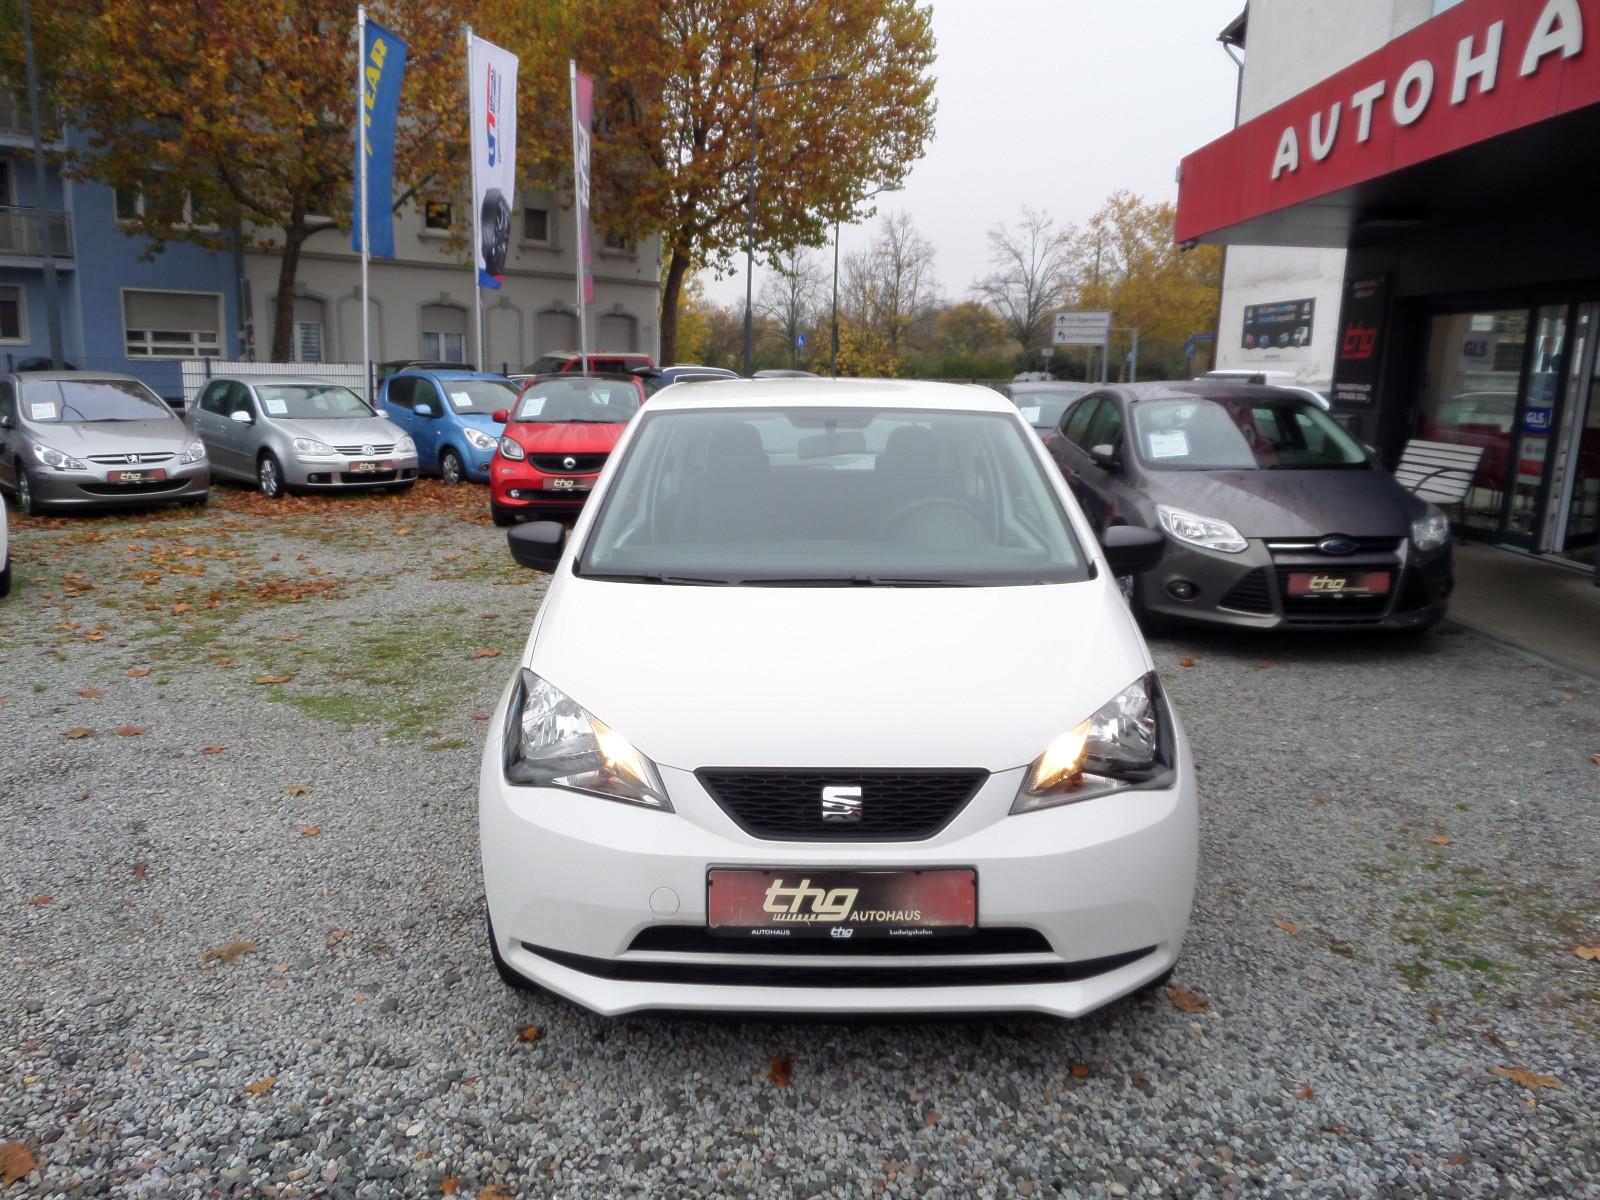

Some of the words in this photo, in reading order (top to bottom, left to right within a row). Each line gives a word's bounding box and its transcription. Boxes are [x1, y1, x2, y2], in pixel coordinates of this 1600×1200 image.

[1270, 0, 1584, 180] AUTOHA
[1526, 412, 1545, 424] GLS
[1309, 575, 1347, 592] thg
[763, 879, 859, 922] thg
[849, 910, 922, 922] AUTOHAUS
[830, 926, 854, 938] thg
[889, 928, 933, 937] Ludwigshafen
